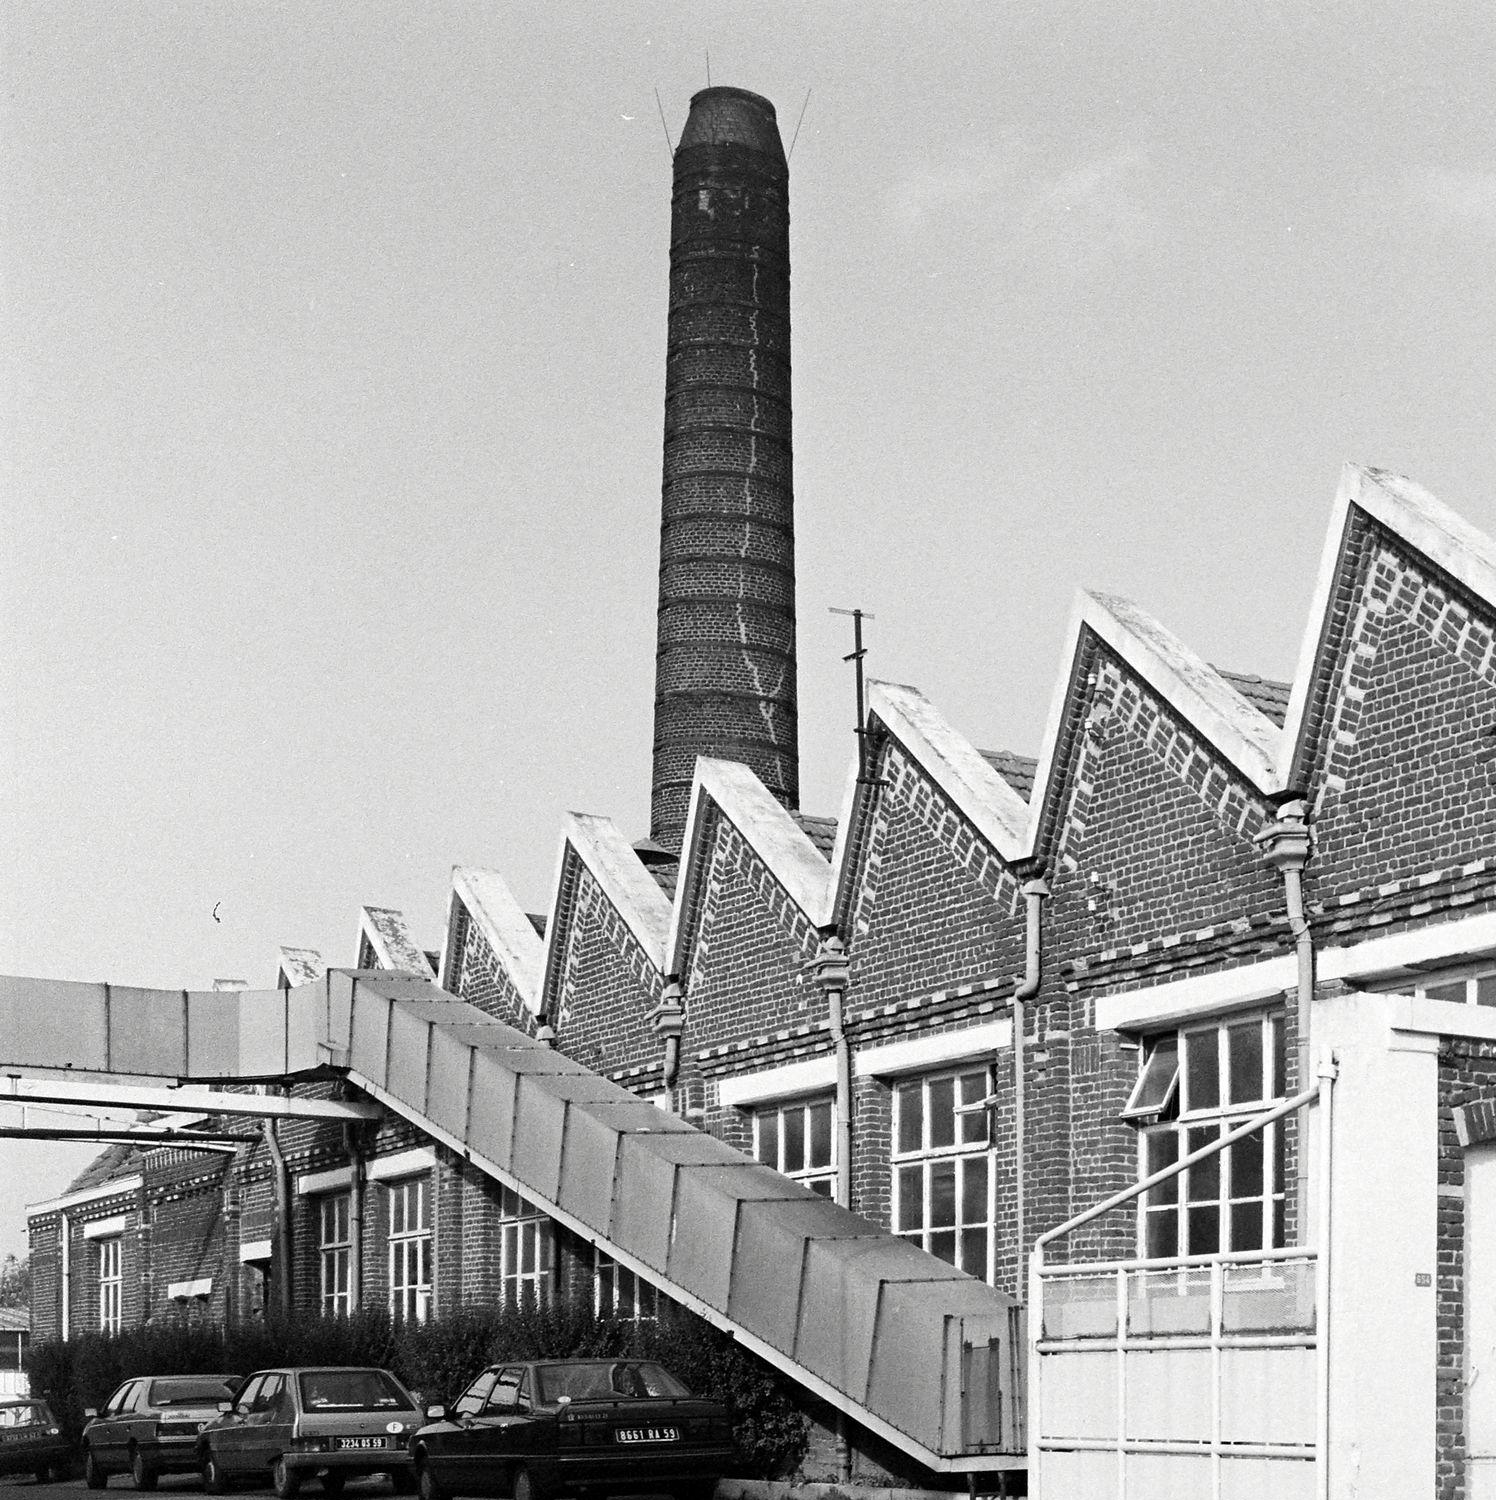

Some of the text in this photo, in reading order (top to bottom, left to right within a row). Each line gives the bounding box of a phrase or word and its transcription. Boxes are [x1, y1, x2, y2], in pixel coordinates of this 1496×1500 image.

[619, 1428, 675, 1440] 8661 RA 59
[341, 1439, 359, 1448] 3234
[372, 1438, 382, 1447] 59
